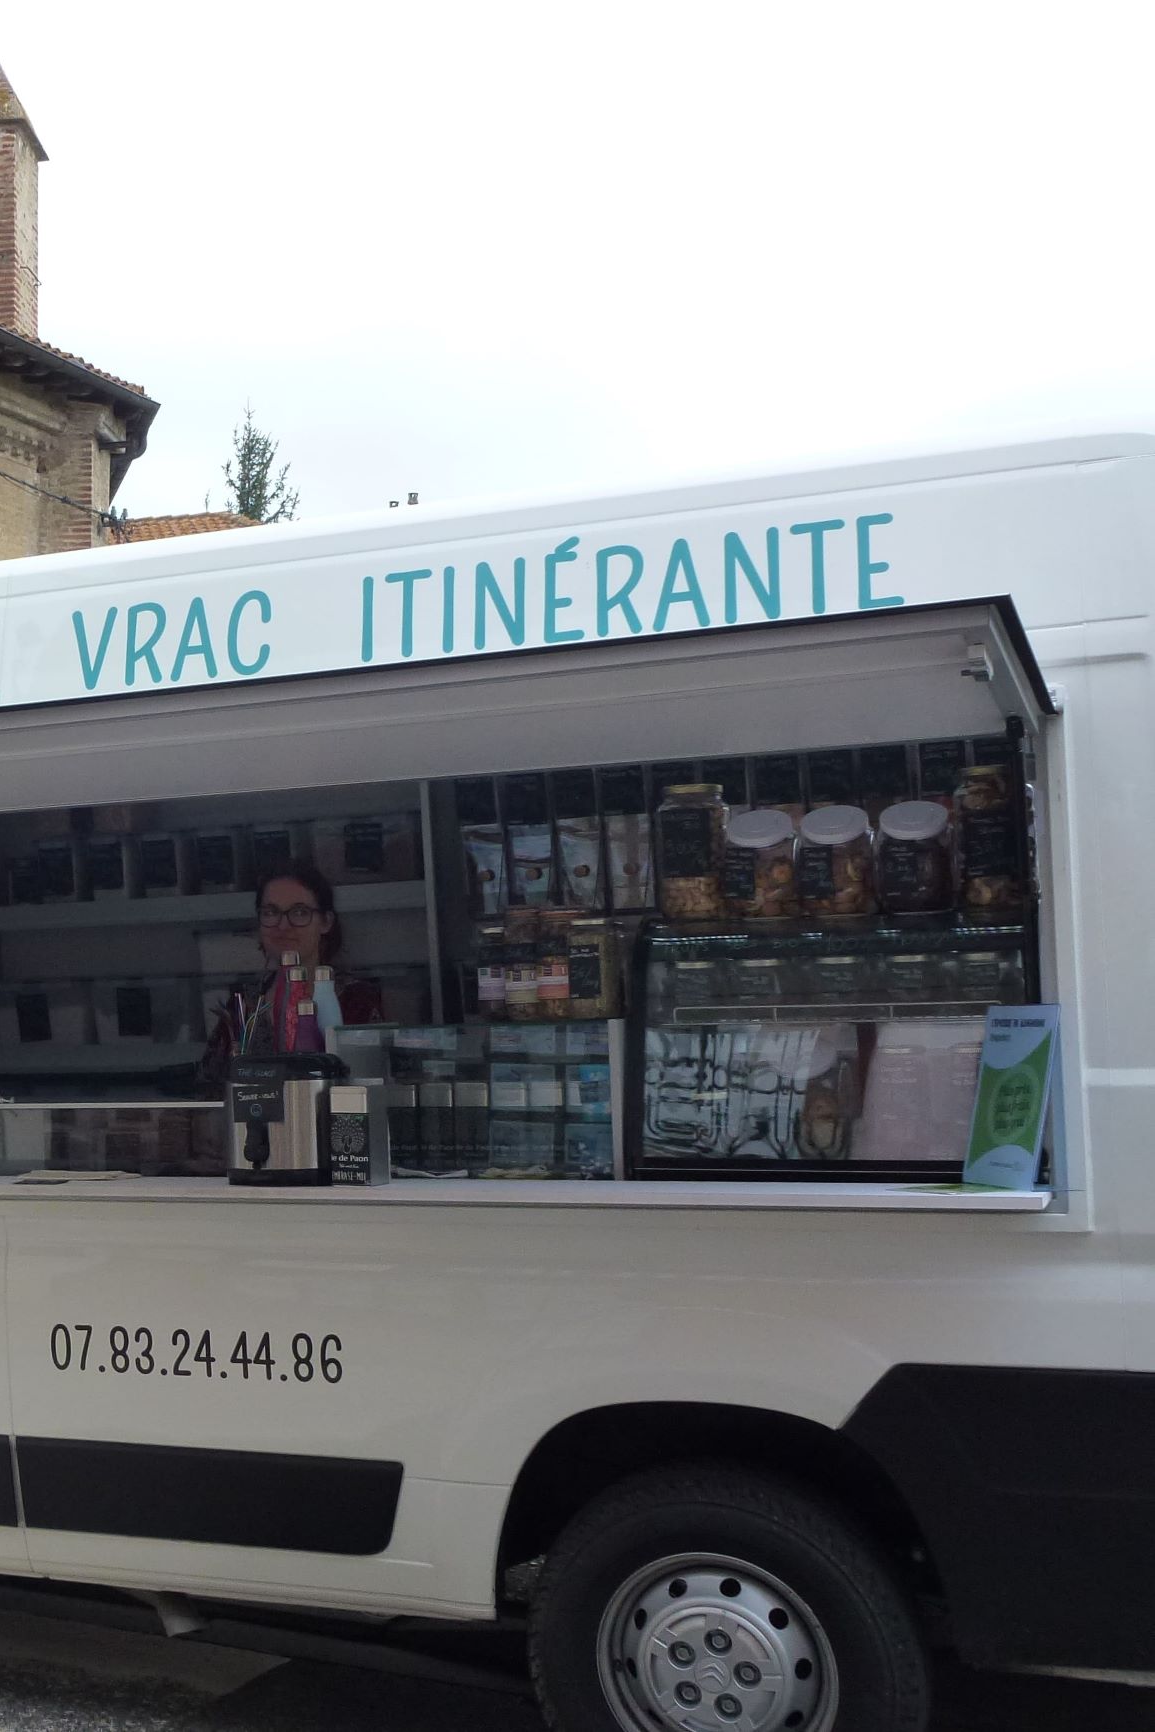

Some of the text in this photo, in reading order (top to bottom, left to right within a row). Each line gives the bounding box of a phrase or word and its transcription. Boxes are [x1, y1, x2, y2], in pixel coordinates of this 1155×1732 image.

[72, 590, 272, 691] VRAC
[361, 513, 905, 662] ITINÉRANTE
[50, 1323, 343, 1384] 07.83.24.44.86
